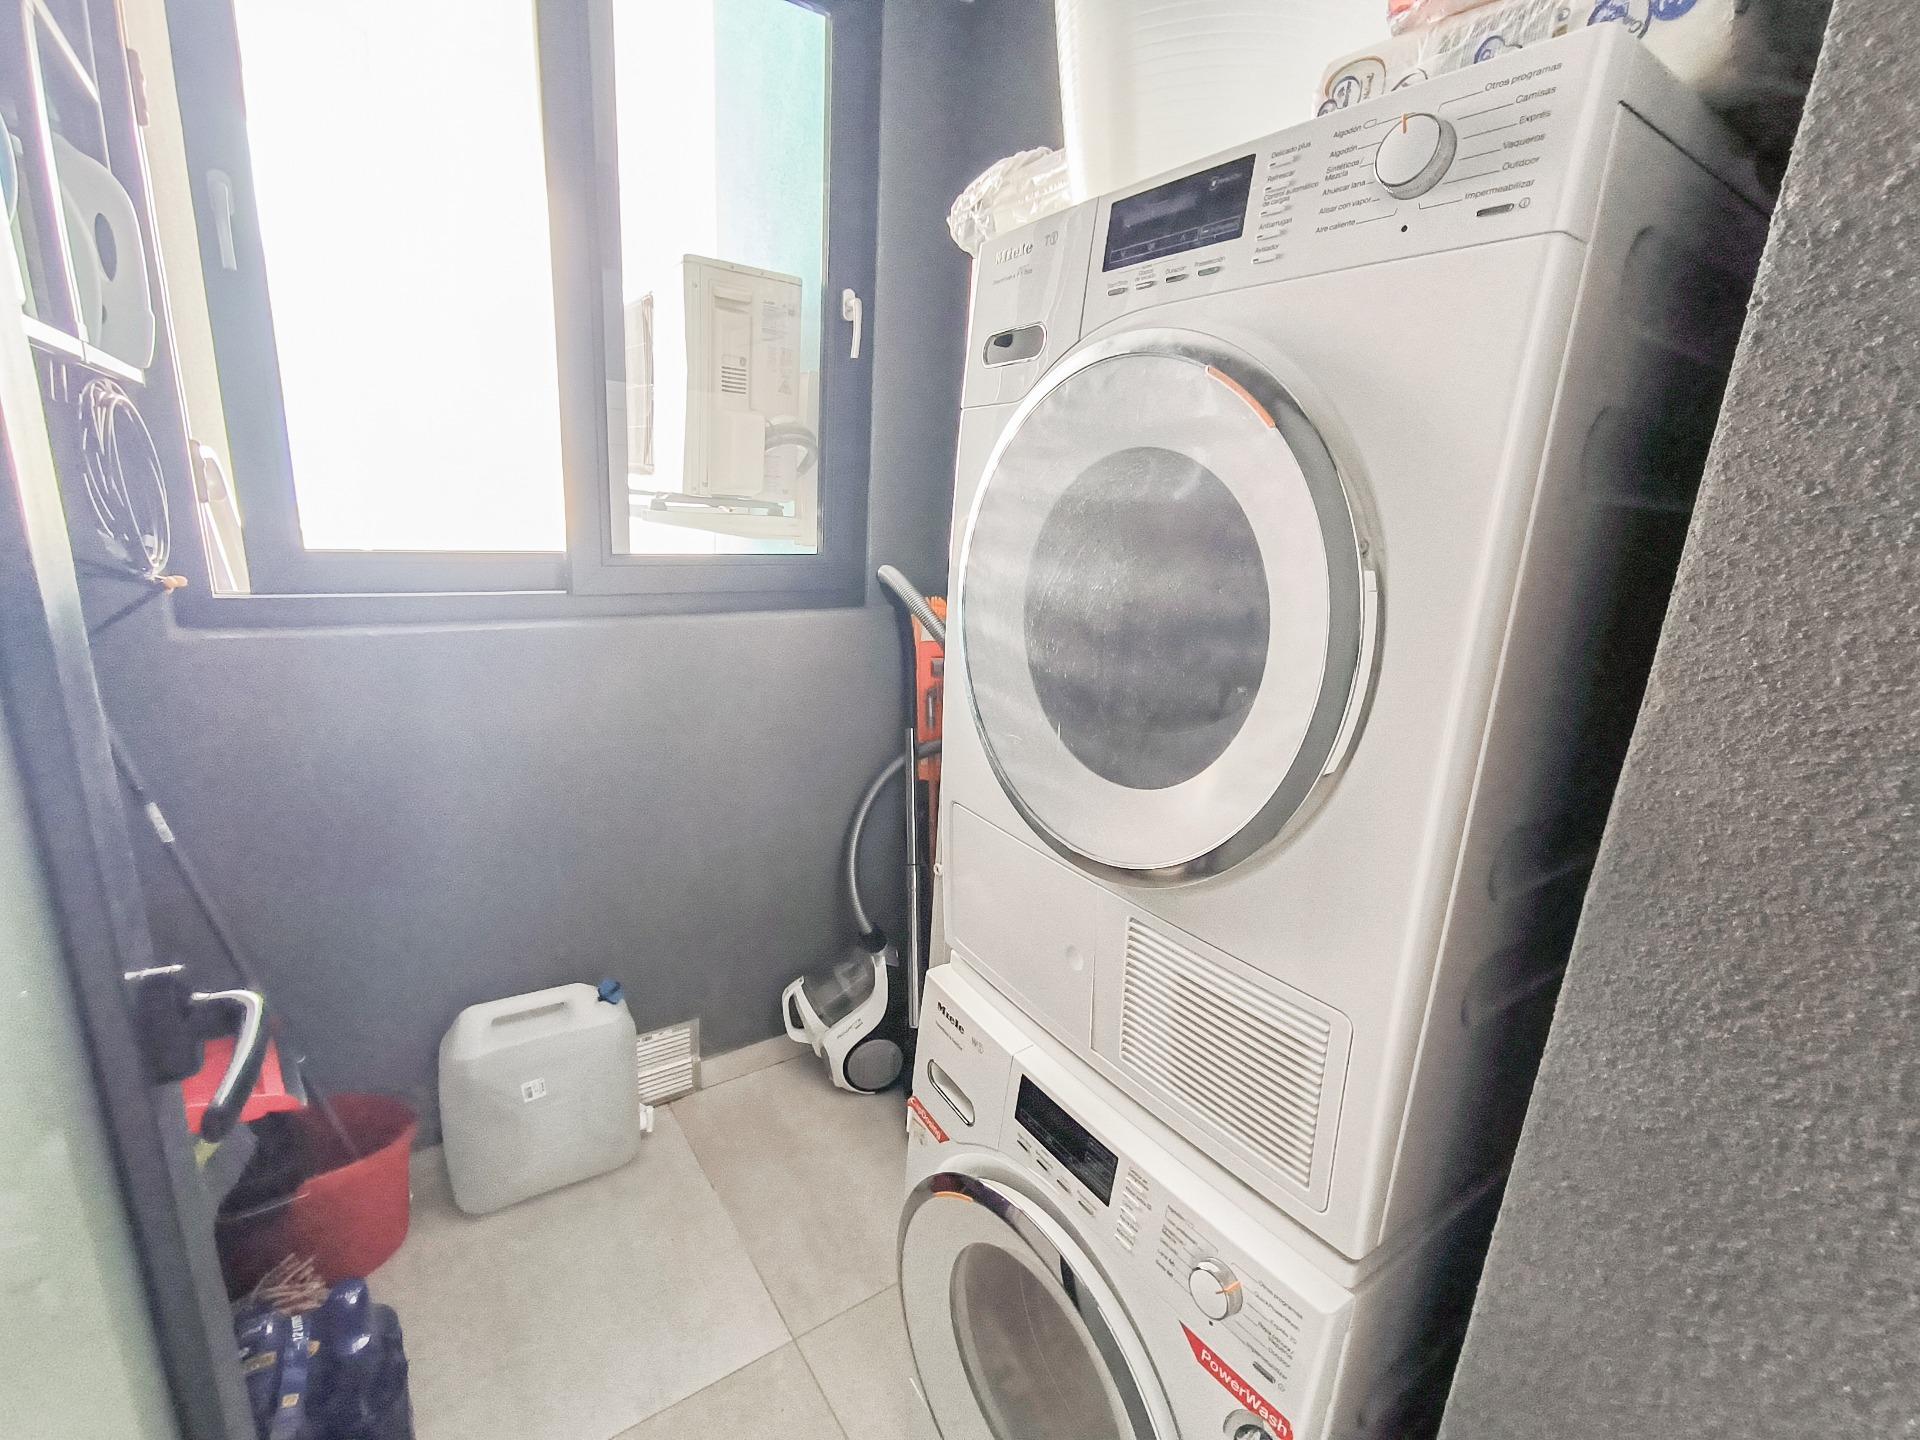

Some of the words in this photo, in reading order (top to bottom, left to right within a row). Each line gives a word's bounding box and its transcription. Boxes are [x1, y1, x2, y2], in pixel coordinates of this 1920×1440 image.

[1484, 79, 1510, 92] Otros
[1510, 62, 1563, 85] programas
[1515, 86, 1557, 104] Camisas
[1502, 133, 1546, 150] Vaqueros
[1502, 156, 1541, 171] Outdoor
[1464, 179, 1536, 200] Impermeabilizar
[1337, 202, 1351, 210] con
[937, 1001, 965, 1034] Miele
[1200, 1348, 1289, 1437] PowerWash
